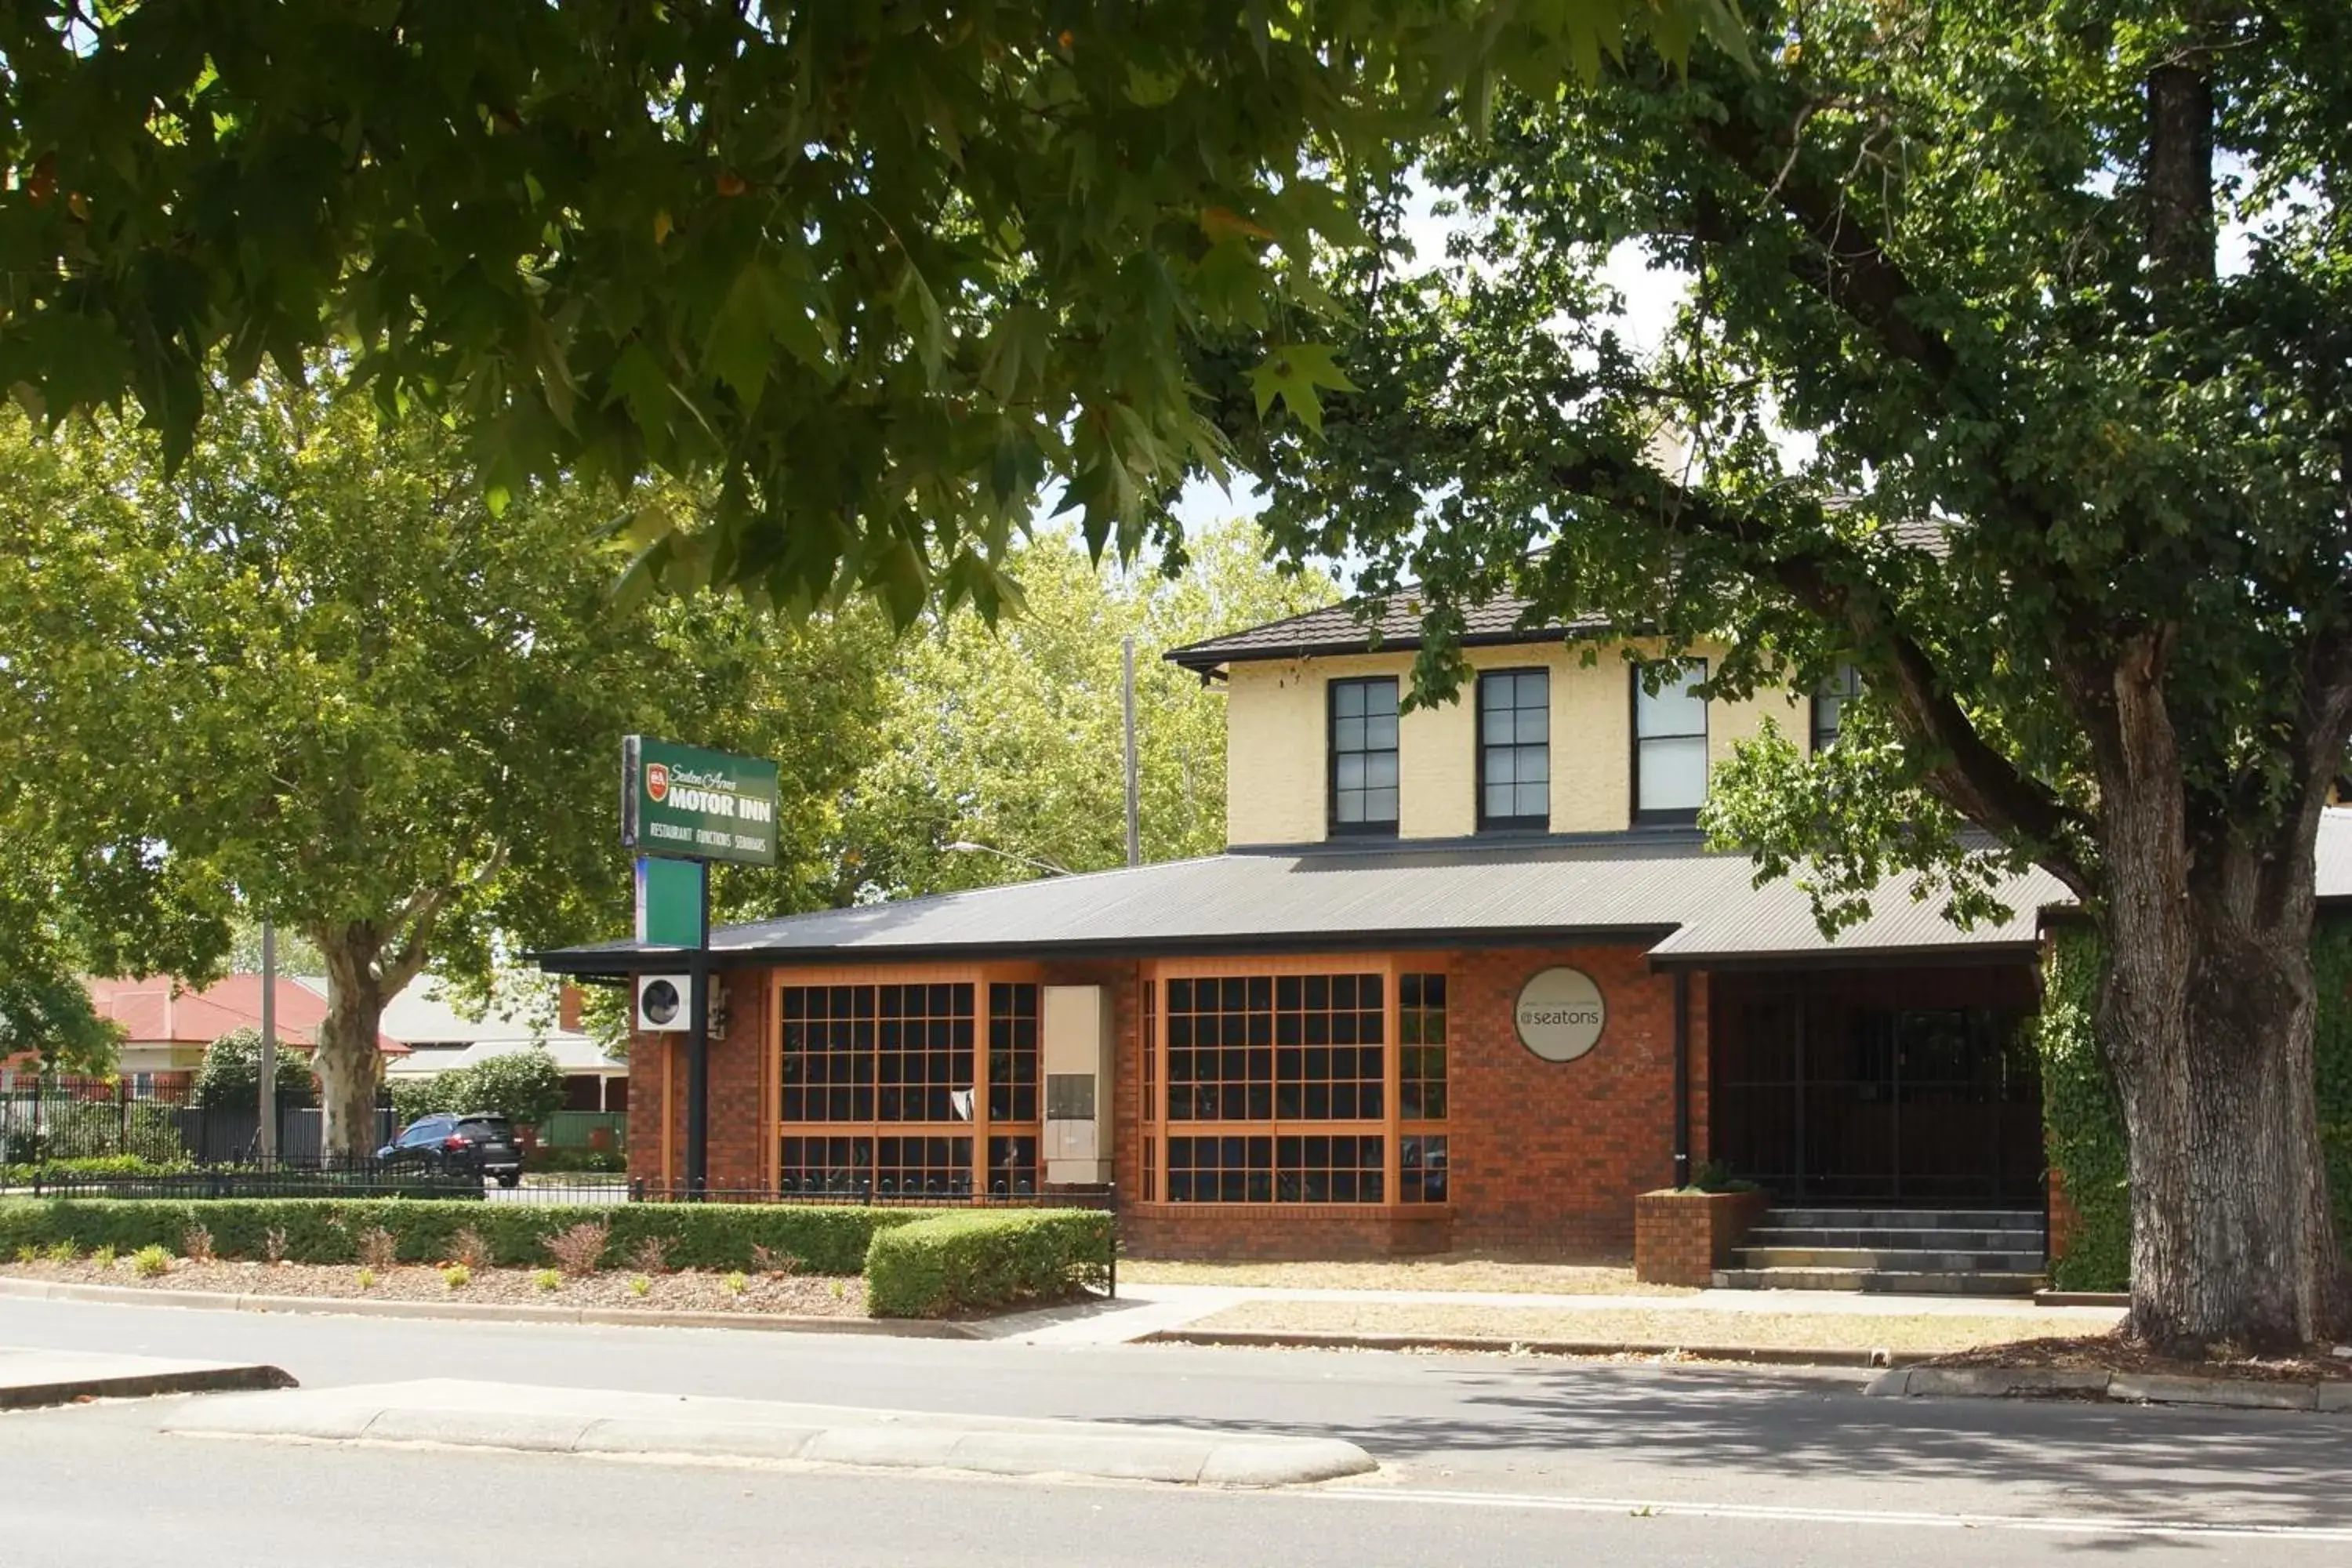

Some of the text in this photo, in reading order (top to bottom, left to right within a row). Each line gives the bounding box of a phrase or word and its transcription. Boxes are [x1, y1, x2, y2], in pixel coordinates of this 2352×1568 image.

[670, 764, 702, 785] Seaton
[668, 786, 771, 823] MOTOR INN
[650, 822, 692, 841] RESTAURANT
[695, 829, 731, 848] FUNCTIONS
[1521, 1009, 1599, 1025] @seatons
